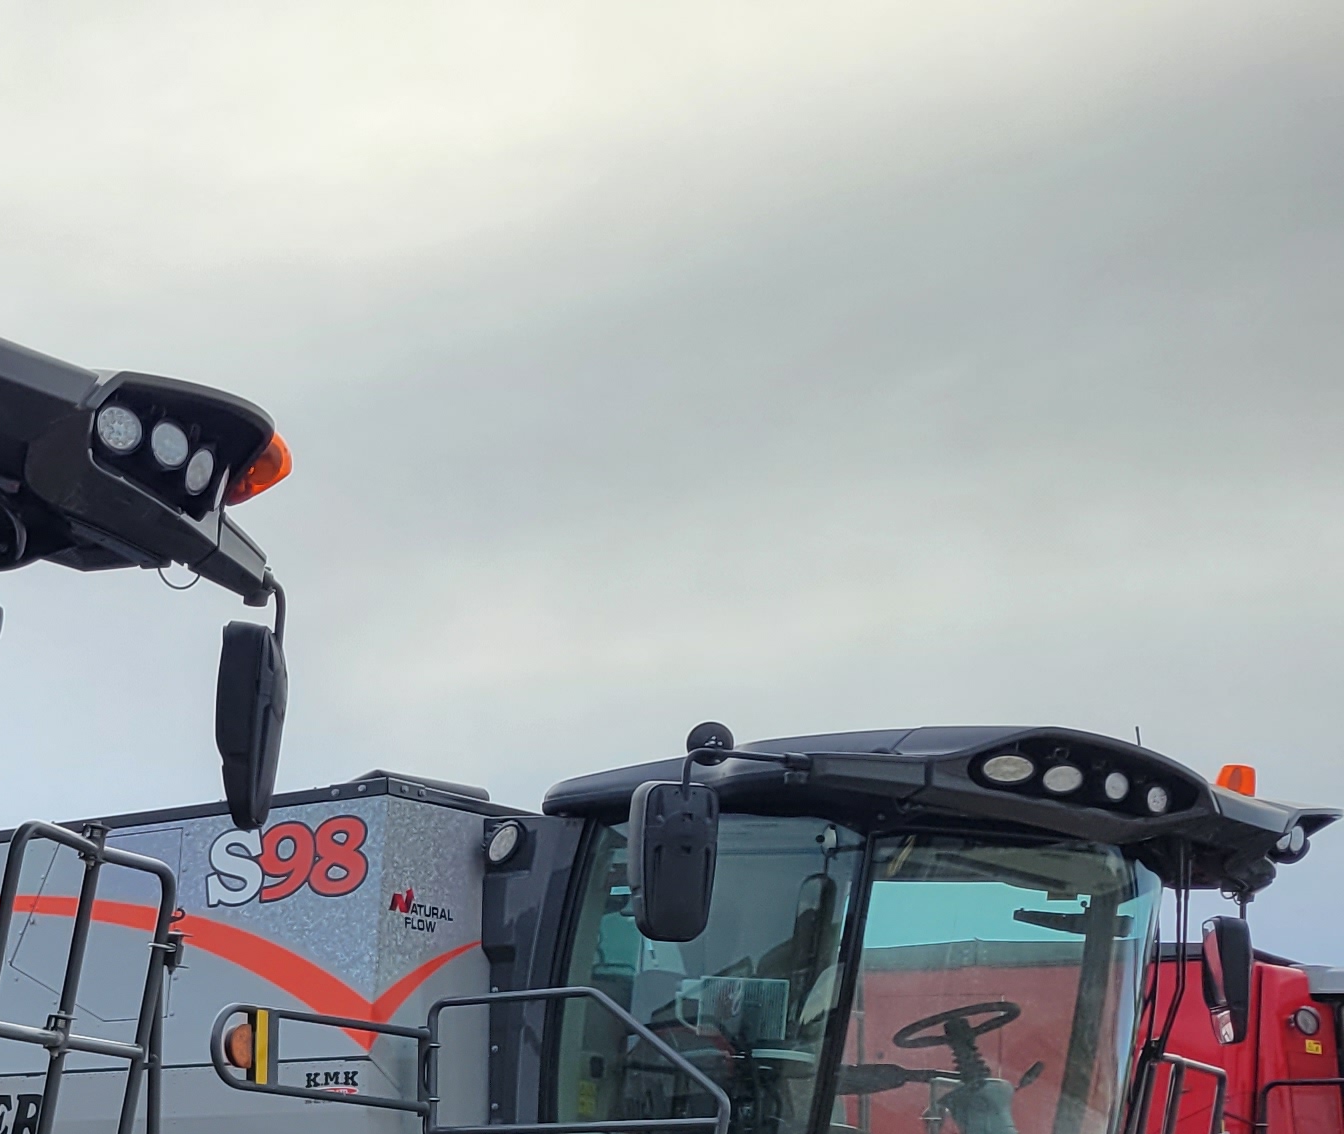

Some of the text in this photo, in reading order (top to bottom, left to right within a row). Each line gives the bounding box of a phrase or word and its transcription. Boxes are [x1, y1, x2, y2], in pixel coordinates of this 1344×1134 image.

[206, 814, 368, 908] S98
[388, 888, 454, 922] NATURAL
[404, 916, 436, 933] FLOW
